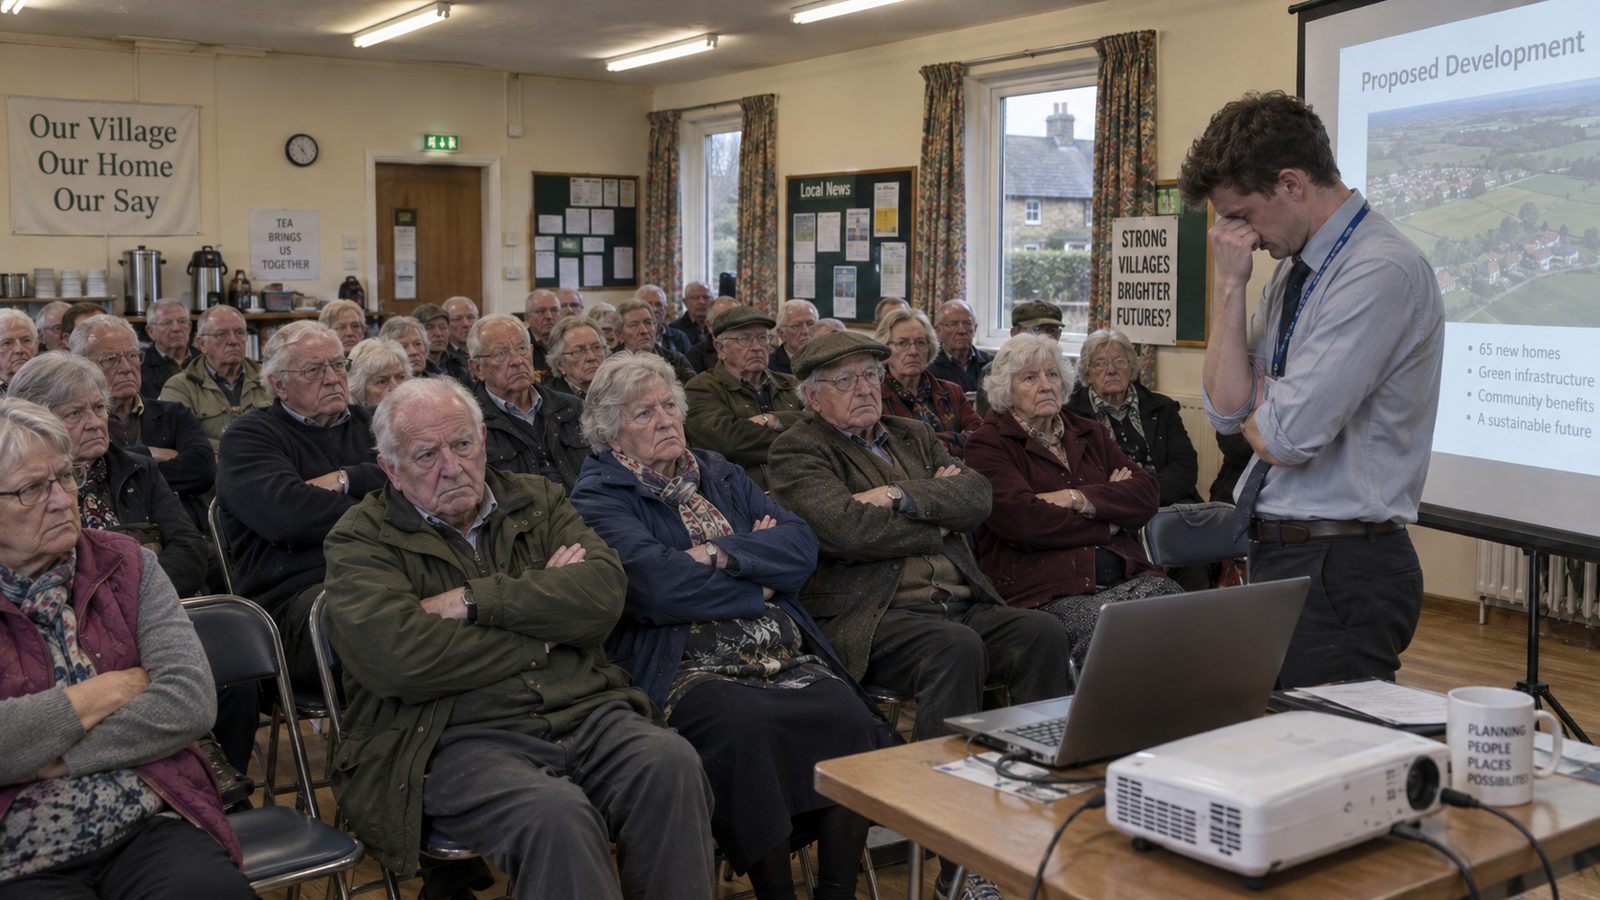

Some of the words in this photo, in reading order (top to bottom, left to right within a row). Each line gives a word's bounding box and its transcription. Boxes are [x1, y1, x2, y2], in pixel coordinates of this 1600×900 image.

[1361, 57, 1440, 93] Proposed
[1446, 30, 1585, 77] Development
[29, 113, 80, 140] Our
[88, 116, 177, 150] Village
[38, 150, 89, 176] Our
[97, 152, 173, 178] Home
[800, 182, 824, 198] Local
[826, 182, 851, 196] News
[53, 187, 105, 213] Our
[114, 188, 160, 220] Say
[277, 218, 293, 229] TEA
[268, 232, 302, 243] BRINGS
[1122, 229, 1167, 248] STRONG
[279, 246, 292, 256] US
[262, 259, 310, 270] TOGETHER
[1118, 255, 1170, 274] VILLAGES
[1117, 282, 1170, 301] BRIGHTER
[1116, 307, 1171, 328] FUTURES?
[1479, 342, 1493, 357] 65
[1496, 345, 1519, 358] new
[1522, 343, 1561, 361] homes
[1478, 365, 1512, 381] Green
[1514, 368, 1595, 387] infrastructure
[1478, 388, 1543, 411] Community
[1546, 394, 1594, 413] benefits
[1477, 412, 1486, 426] A
[1488, 415, 1552, 434] sustainable
[1555, 419, 1593, 439] future
[1468, 724, 1526, 737] PLANNING
[1468, 741, 1511, 754] PEOPLE
[1468, 757, 1511, 771] PLACES
